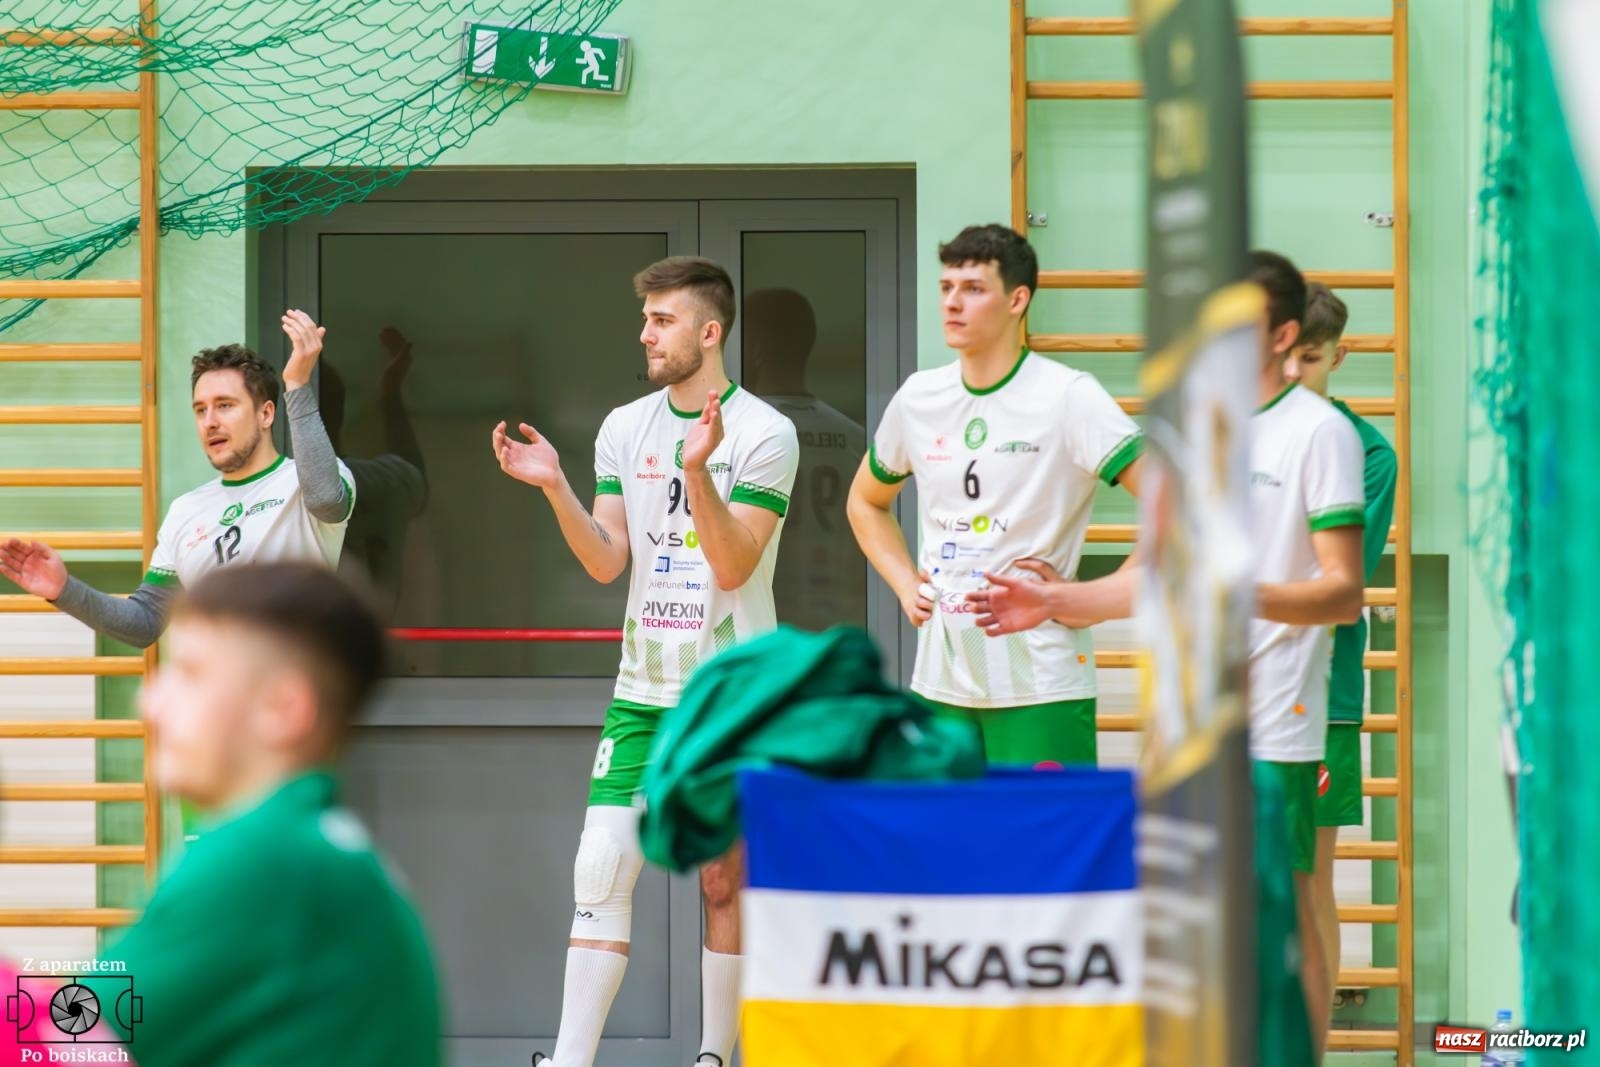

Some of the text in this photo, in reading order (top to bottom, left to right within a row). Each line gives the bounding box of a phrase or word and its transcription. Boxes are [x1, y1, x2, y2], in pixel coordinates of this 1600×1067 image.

[964, 459, 980, 500] 6
[936, 515, 1009, 533] VISON
[215, 525, 241, 563] 12
[647, 531, 700, 549] VISO
[642, 601, 704, 619] PIVEXIN
[641, 618, 704, 630] TECHNOLOGY
